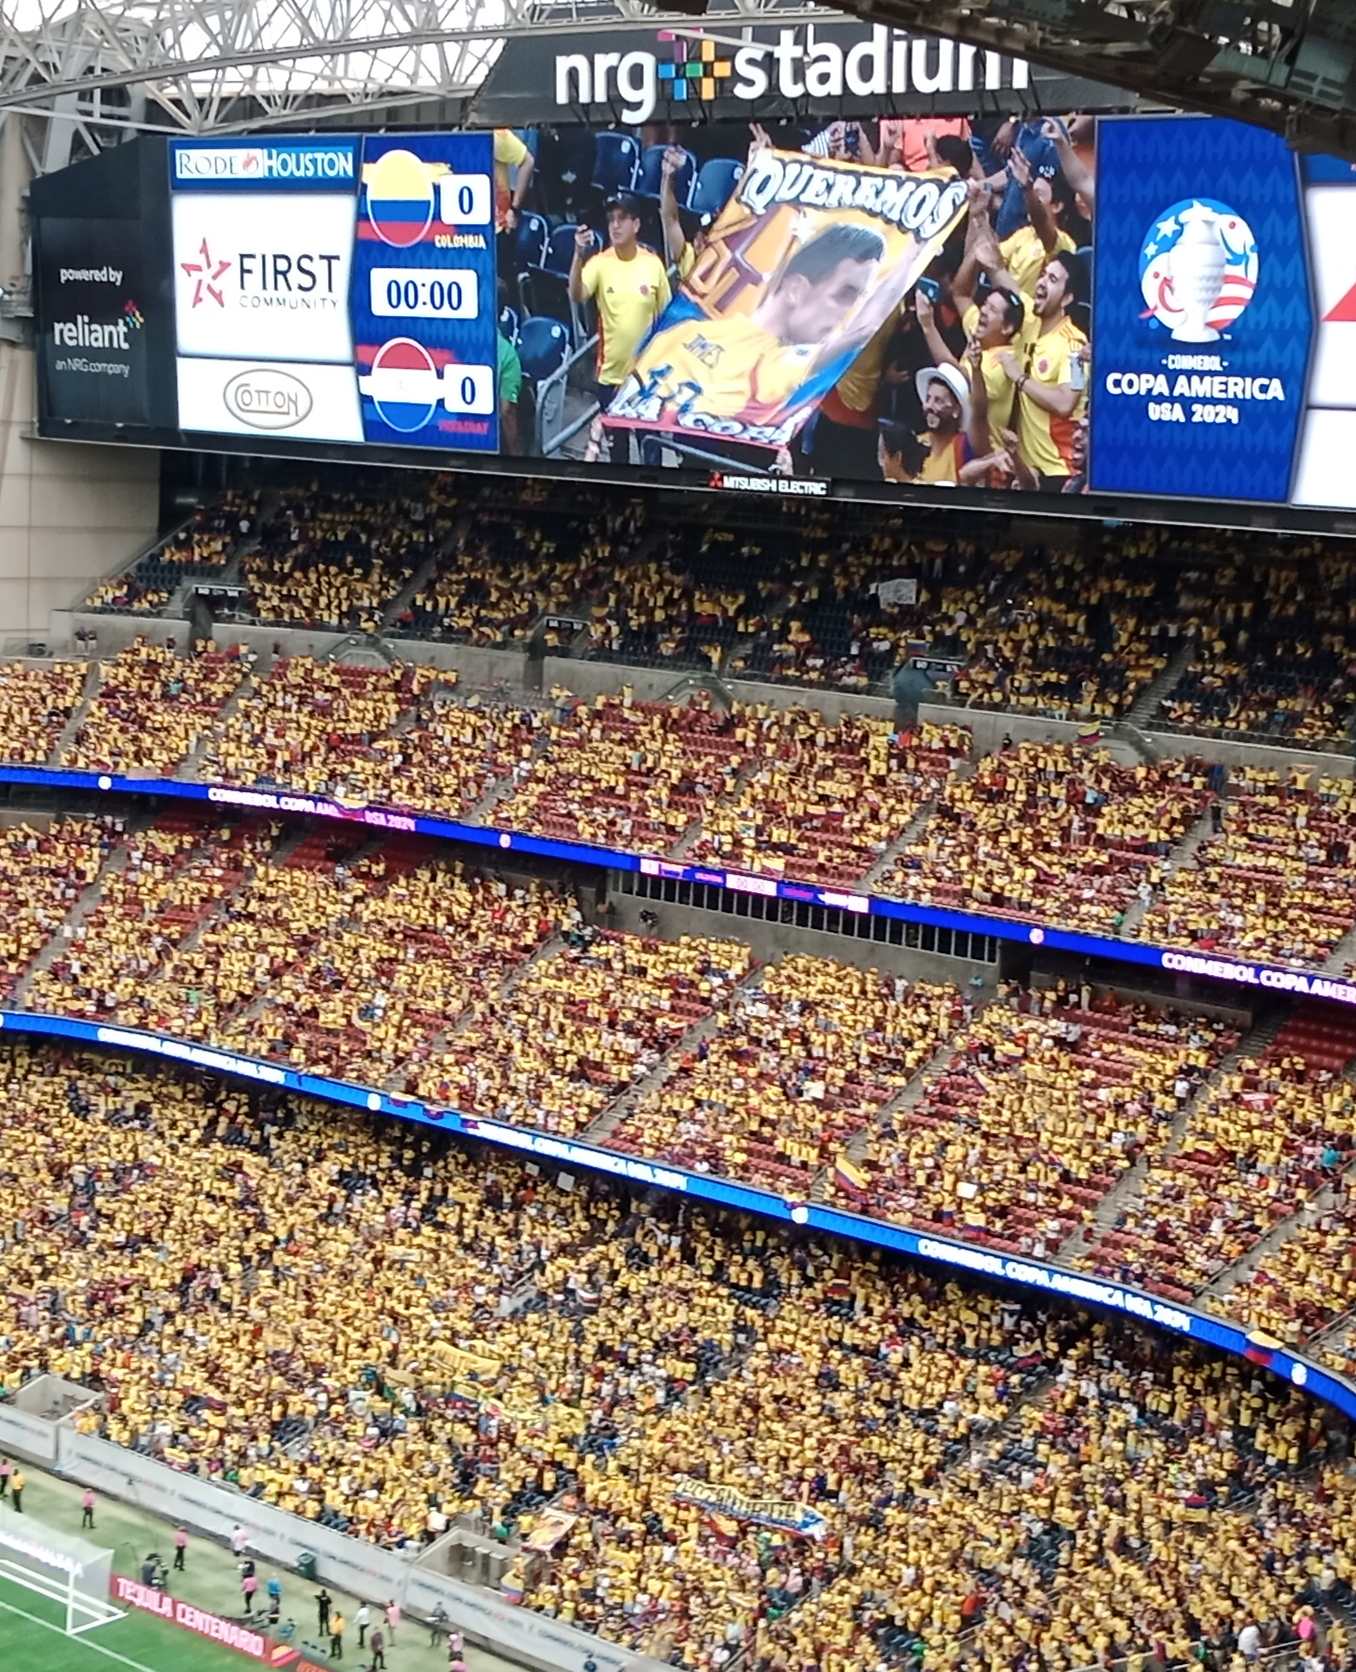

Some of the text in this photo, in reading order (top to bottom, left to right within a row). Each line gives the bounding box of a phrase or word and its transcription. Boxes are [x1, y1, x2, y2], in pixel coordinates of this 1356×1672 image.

[555, 23, 1030, 125] nrg stadium
[458, 185, 474, 216] 0
[741, 158, 969, 240] QUEREMOS
[434, 233, 486, 250] COLOMBIA
[59, 265, 123, 287] powered by
[238, 252, 341, 293] FIRST
[239, 295, 339, 310] COMMUNITY
[386, 279, 463, 311] 00:00
[53, 313, 131, 350] reliant
[67, 357, 89, 372] NRG
[89, 362, 131, 378] company
[1167, 353, 1223, 371] CONMEBOL
[234, 383, 300, 417] COTTON
[461, 376, 476, 405] 0
[1105, 371, 1286, 401] COPA AMERICA
[1148, 401, 1240, 425] USA 2024
[723, 475, 827, 495] MITSUBISHI ELECTRIC
[1161, 952, 1260, 984] CONMEBOL
[1260, 970, 1310, 993] COPA
[116, 1577, 265, 1657] TEQUILA CENTENARIO
